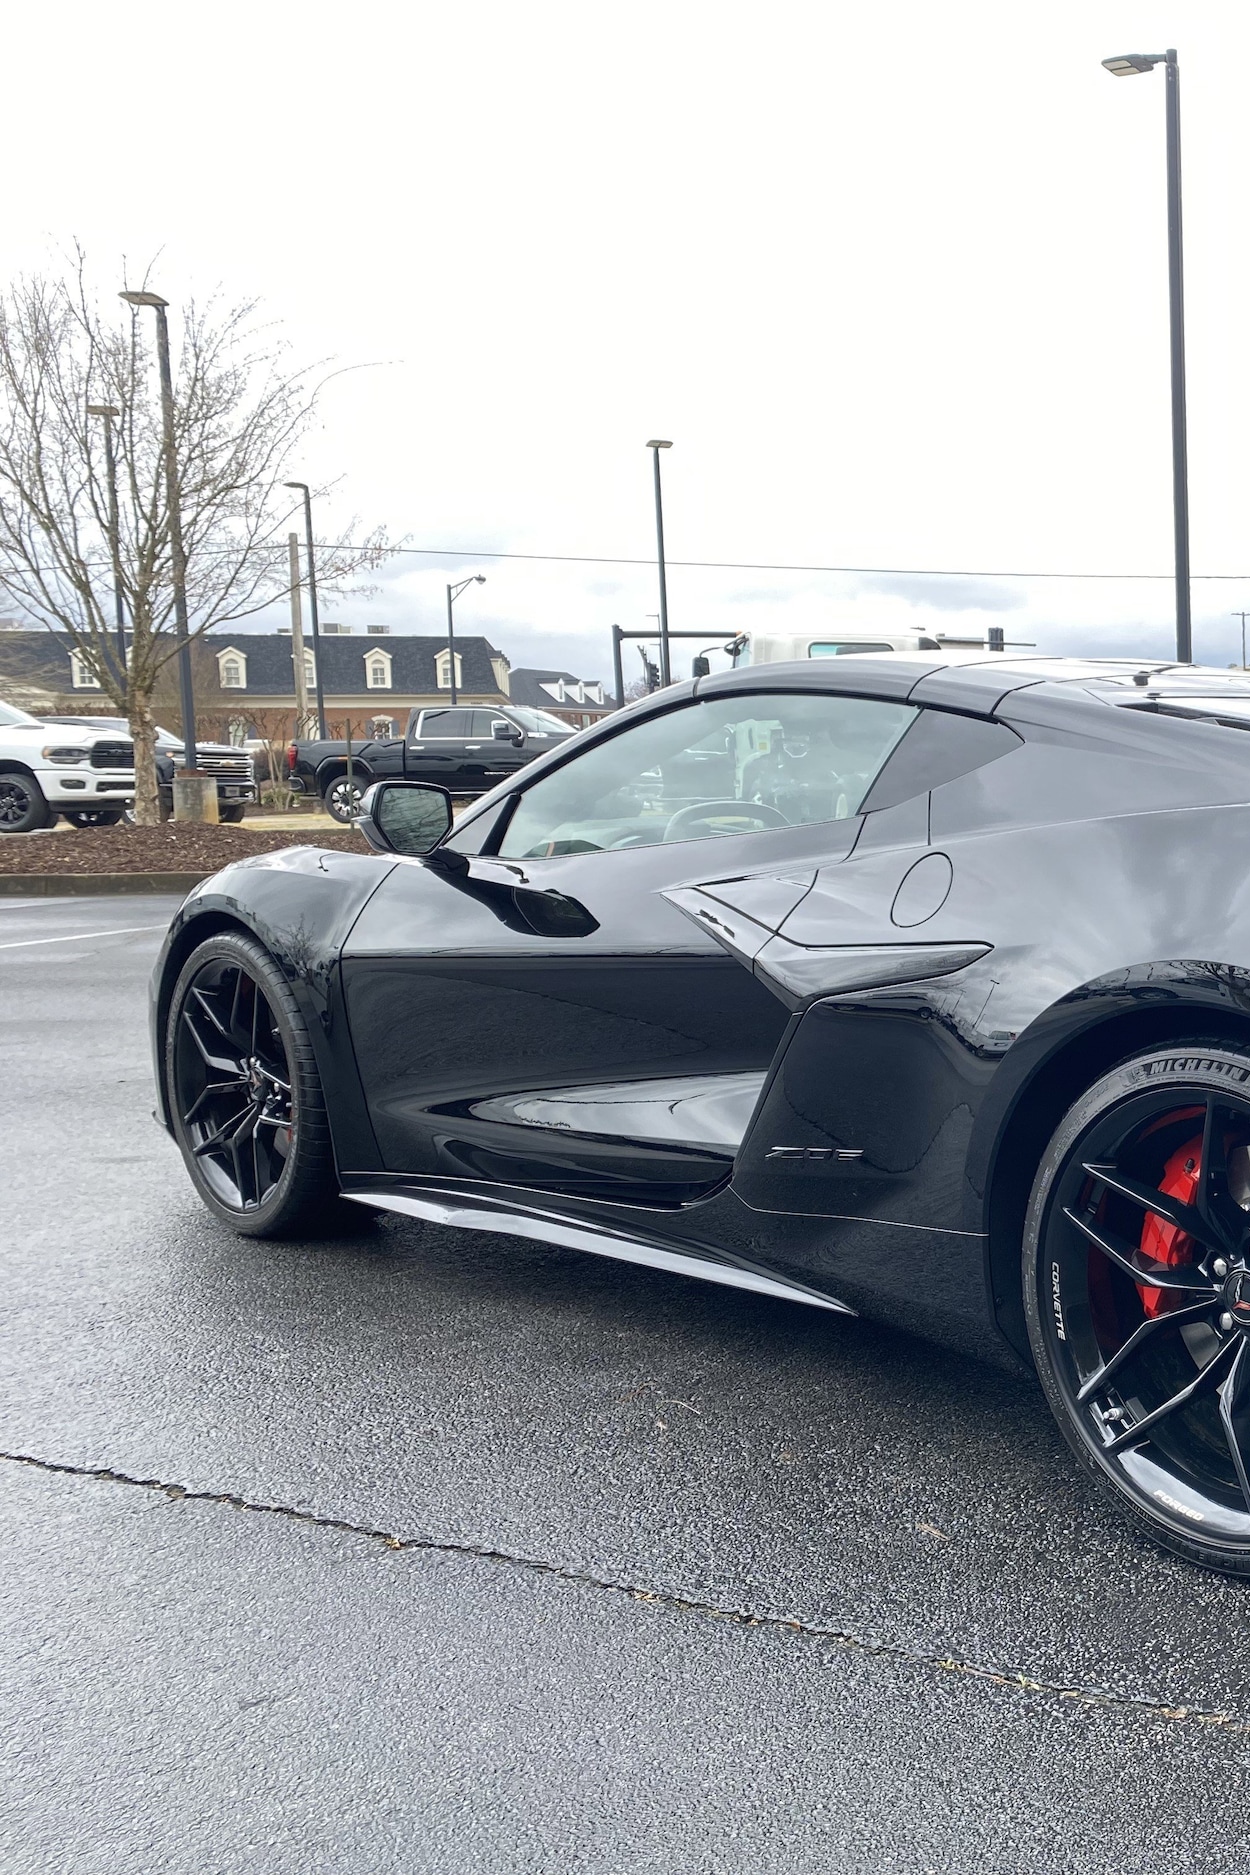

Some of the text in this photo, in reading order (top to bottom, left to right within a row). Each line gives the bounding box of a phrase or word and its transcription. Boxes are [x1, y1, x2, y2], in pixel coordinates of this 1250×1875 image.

[1149, 1058, 1245, 1081] MICHELIN
[1051, 1262, 1067, 1341] CORVETTE
[1153, 1490, 1205, 1521] FORGED
